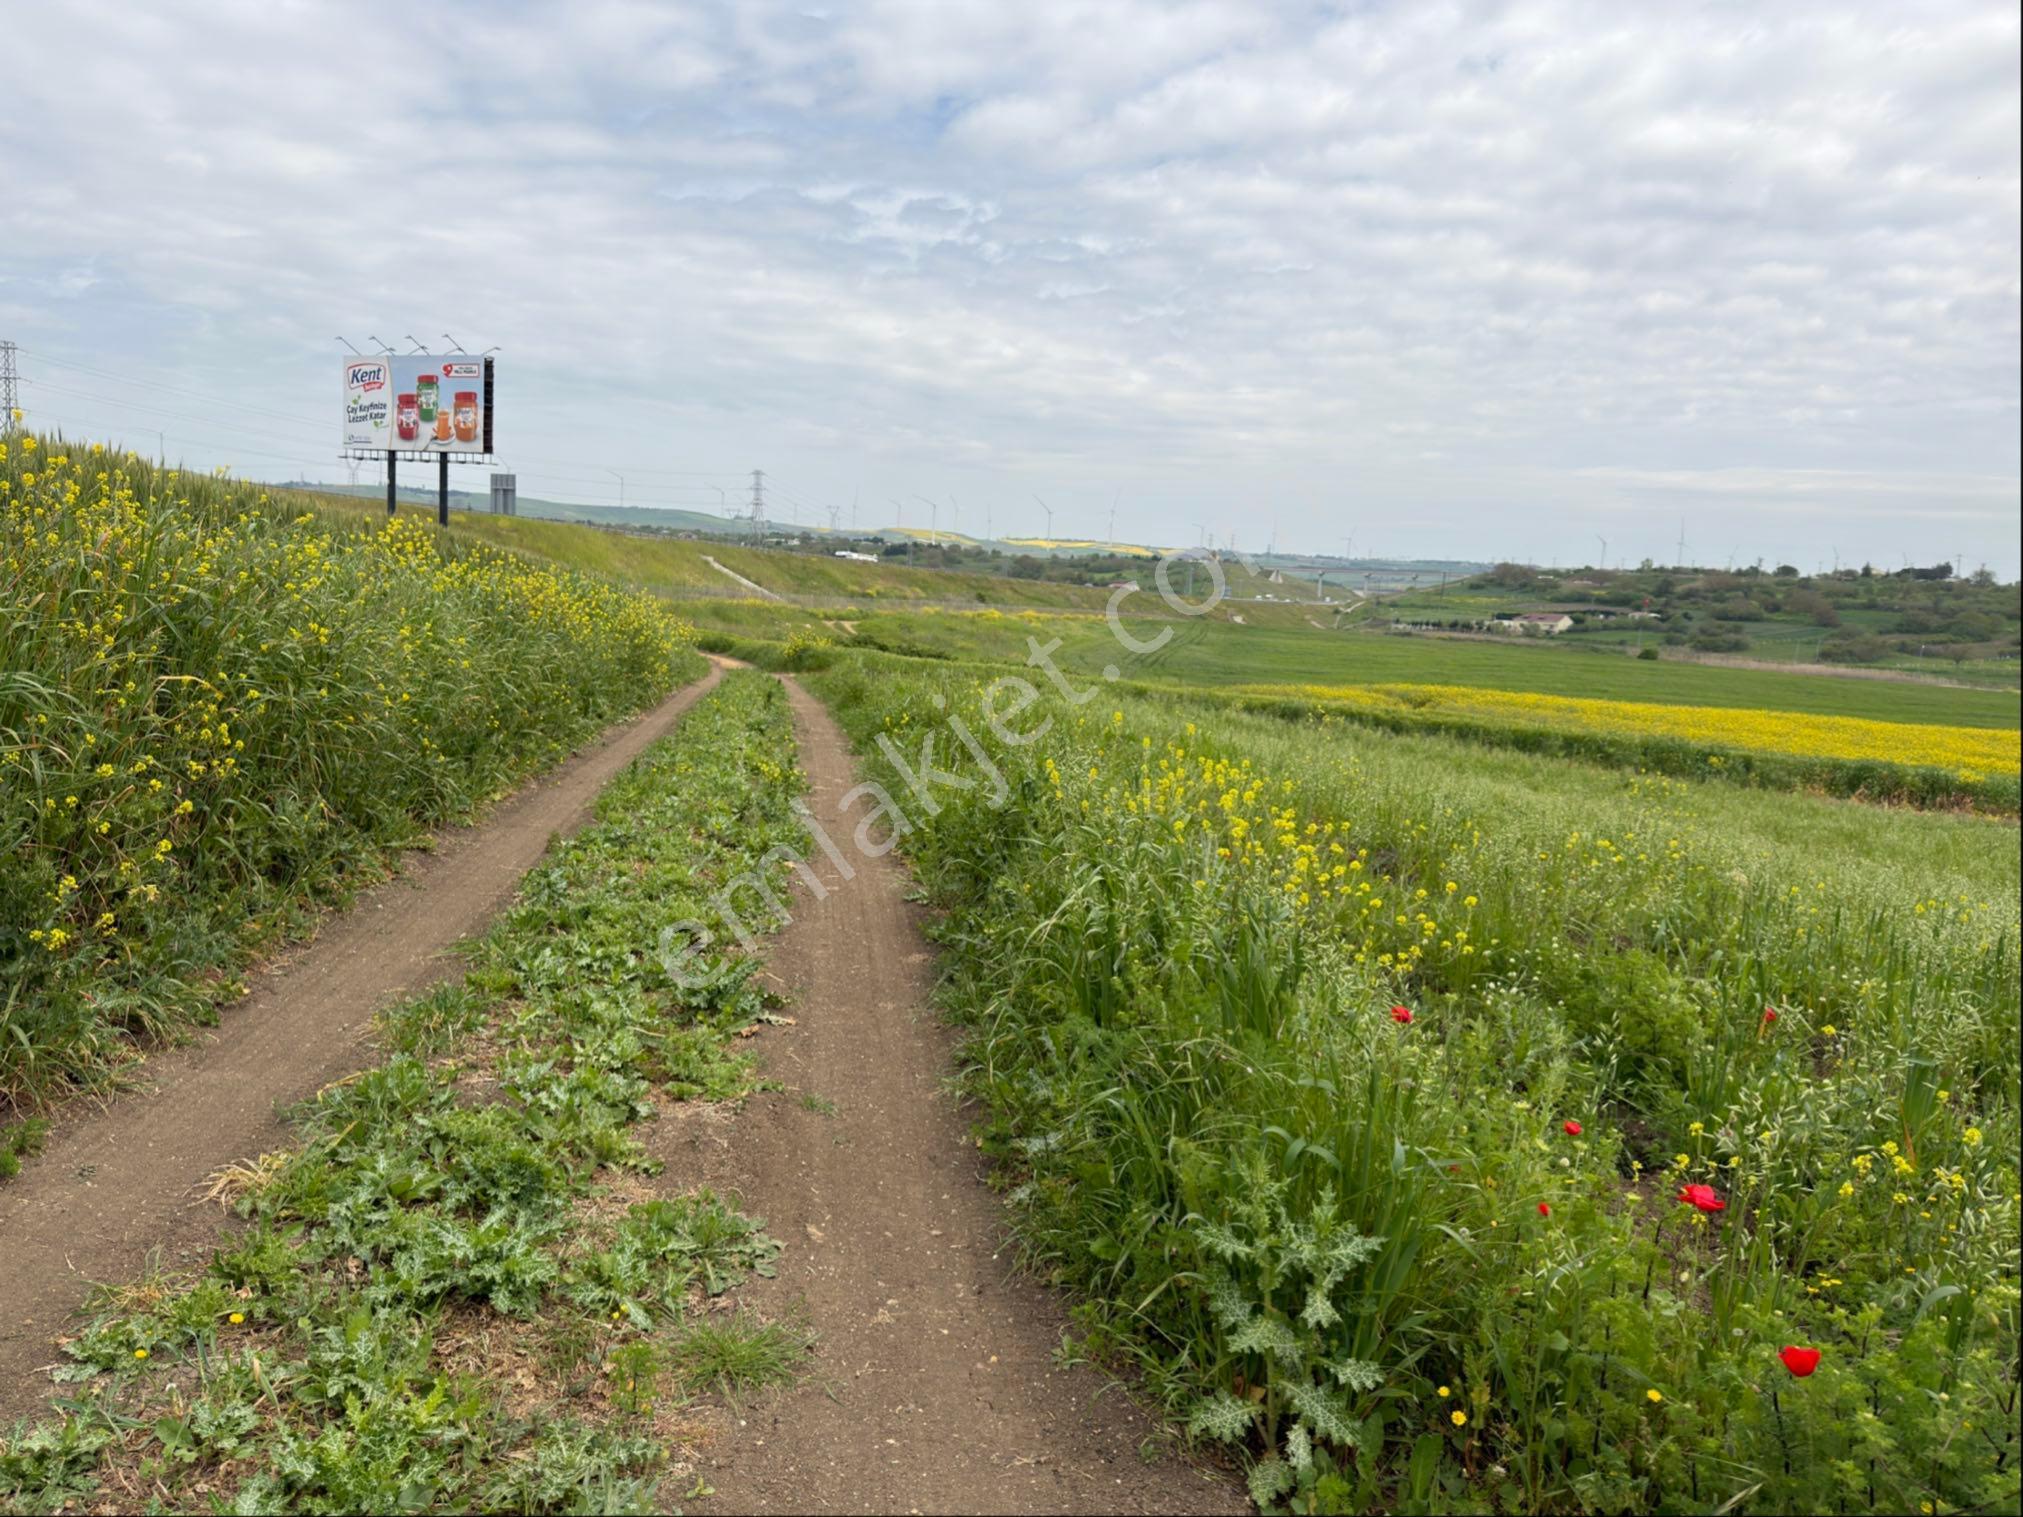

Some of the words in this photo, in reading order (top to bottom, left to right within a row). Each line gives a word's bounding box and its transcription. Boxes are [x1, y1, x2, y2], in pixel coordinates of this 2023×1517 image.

[351, 366, 382, 384] Kent
[348, 414, 368, 423] Lezzet
[369, 410, 386, 420] Katar
